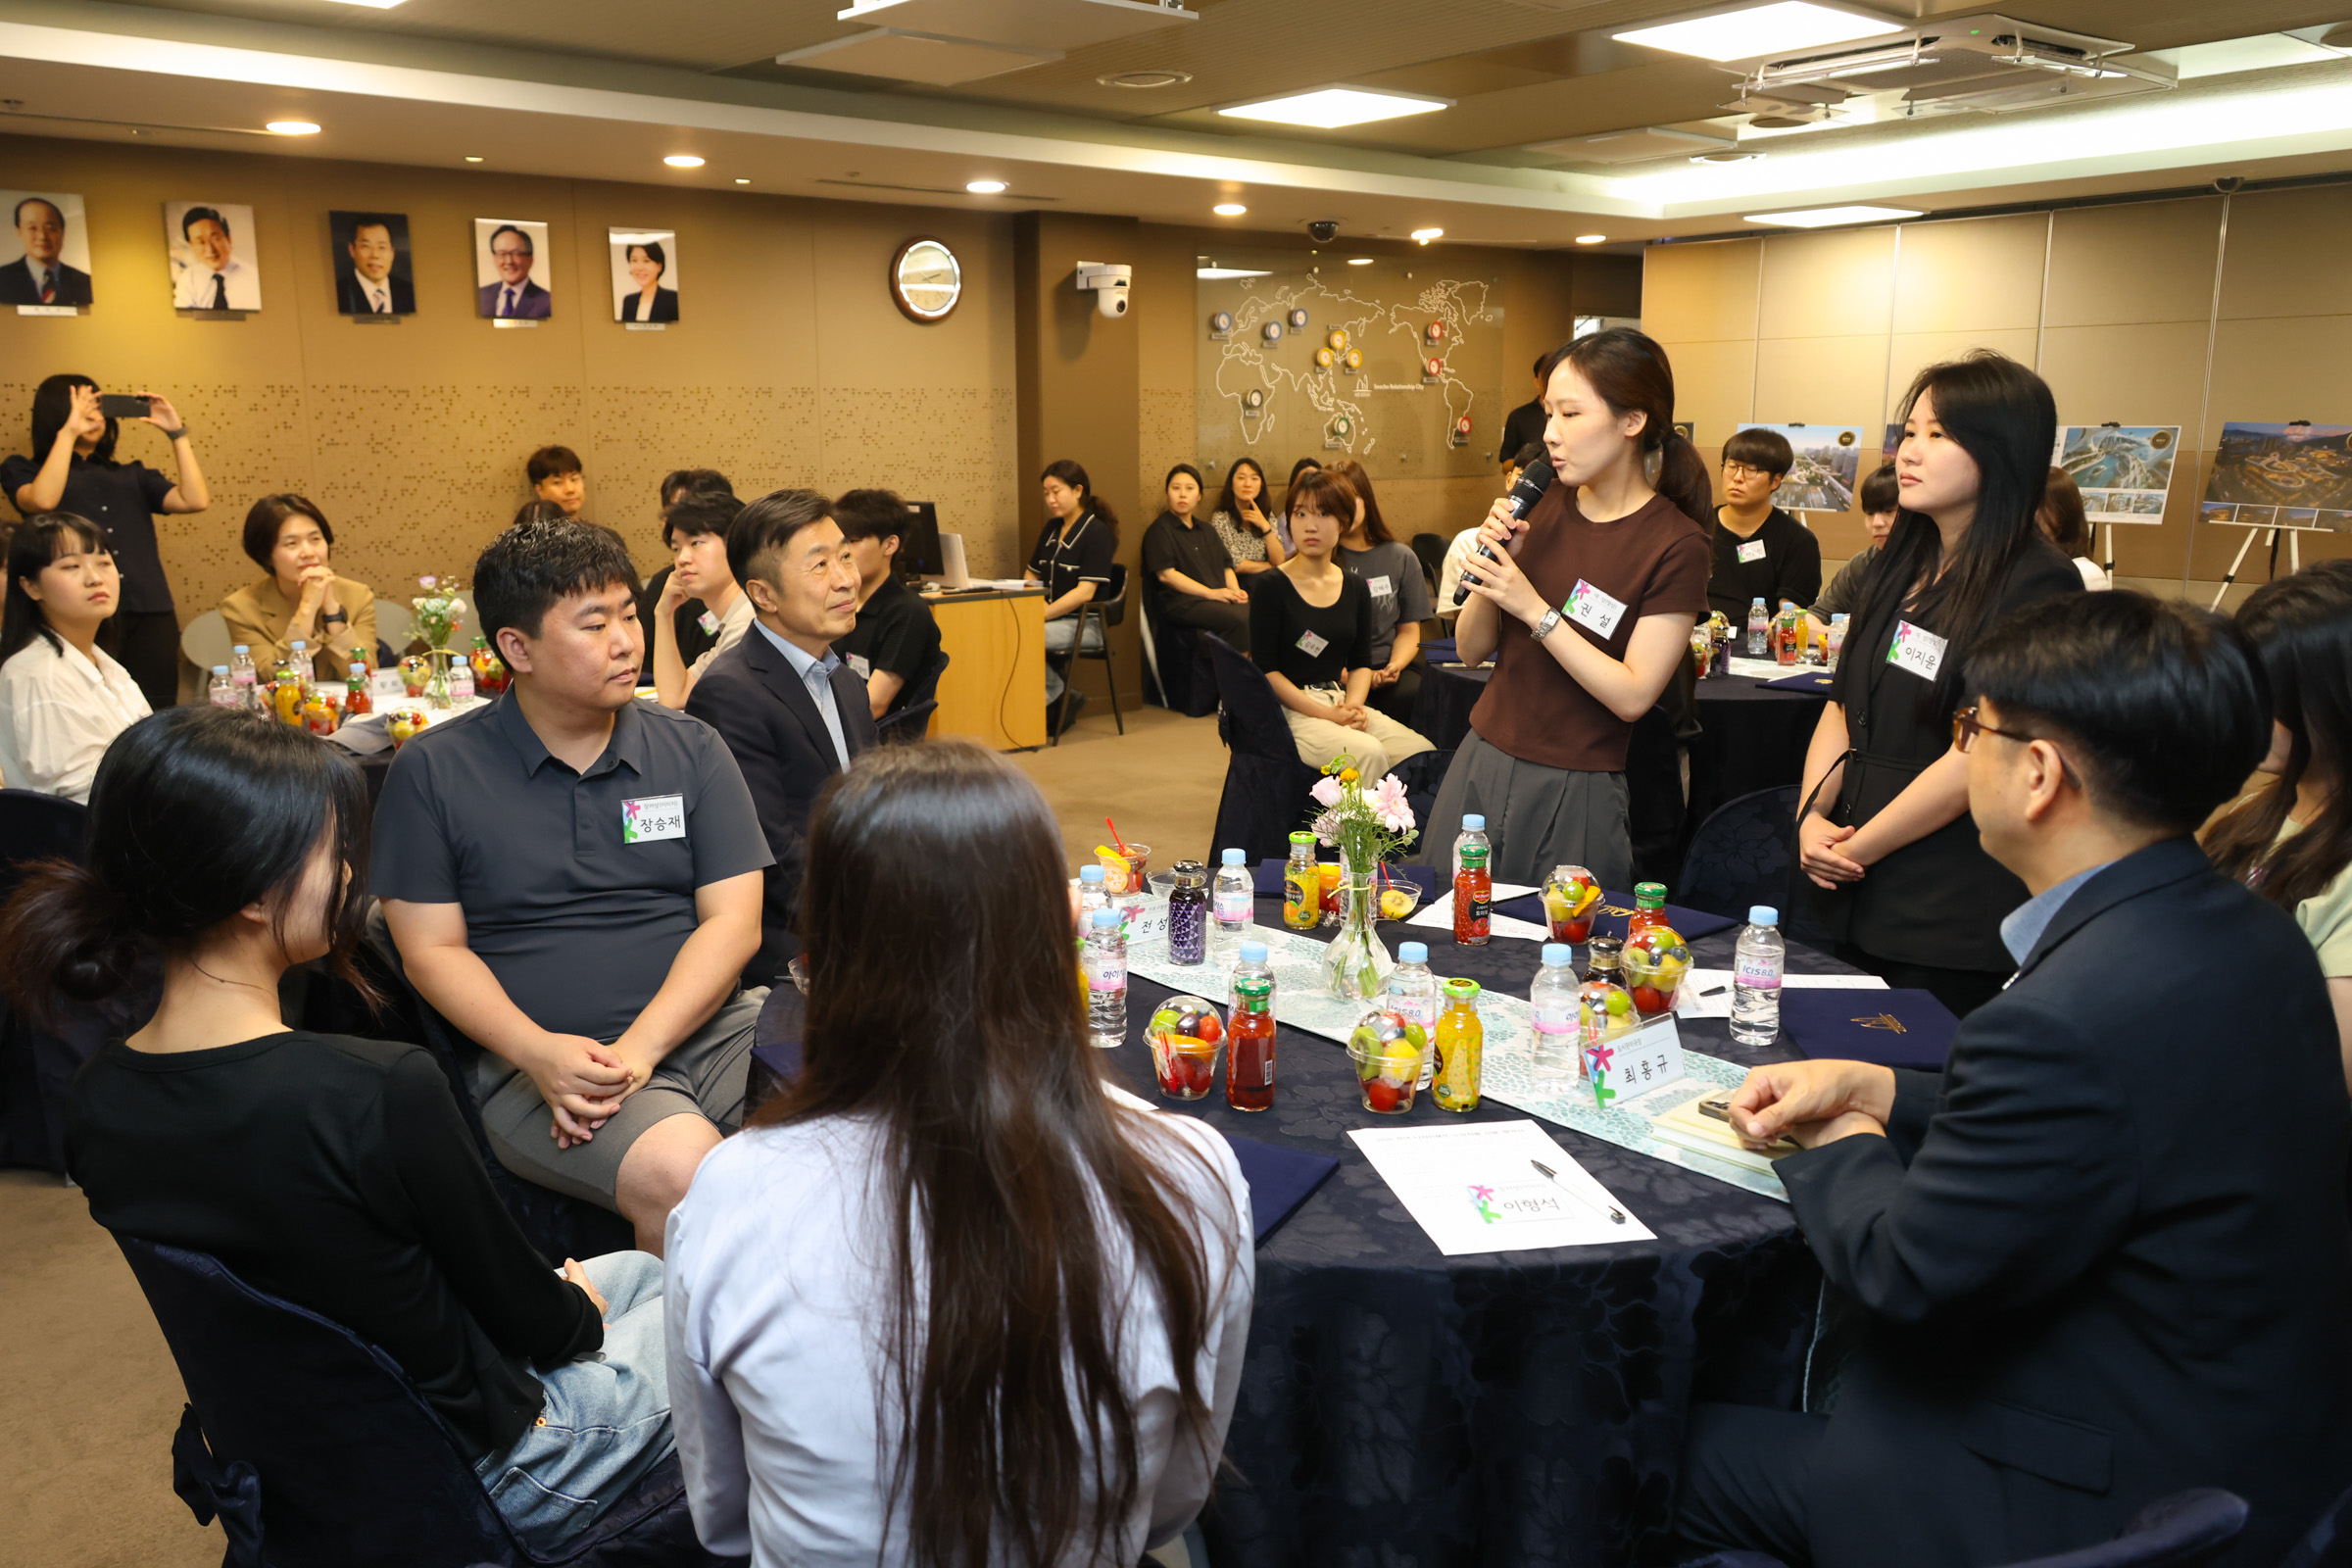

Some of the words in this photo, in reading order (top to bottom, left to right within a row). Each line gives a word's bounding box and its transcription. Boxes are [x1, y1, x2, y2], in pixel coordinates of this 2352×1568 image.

[1905, 647, 1936, 670] 이지윤
[640, 814, 681, 833] 장승재
[1503, 1197, 1560, 1212] 이형석
